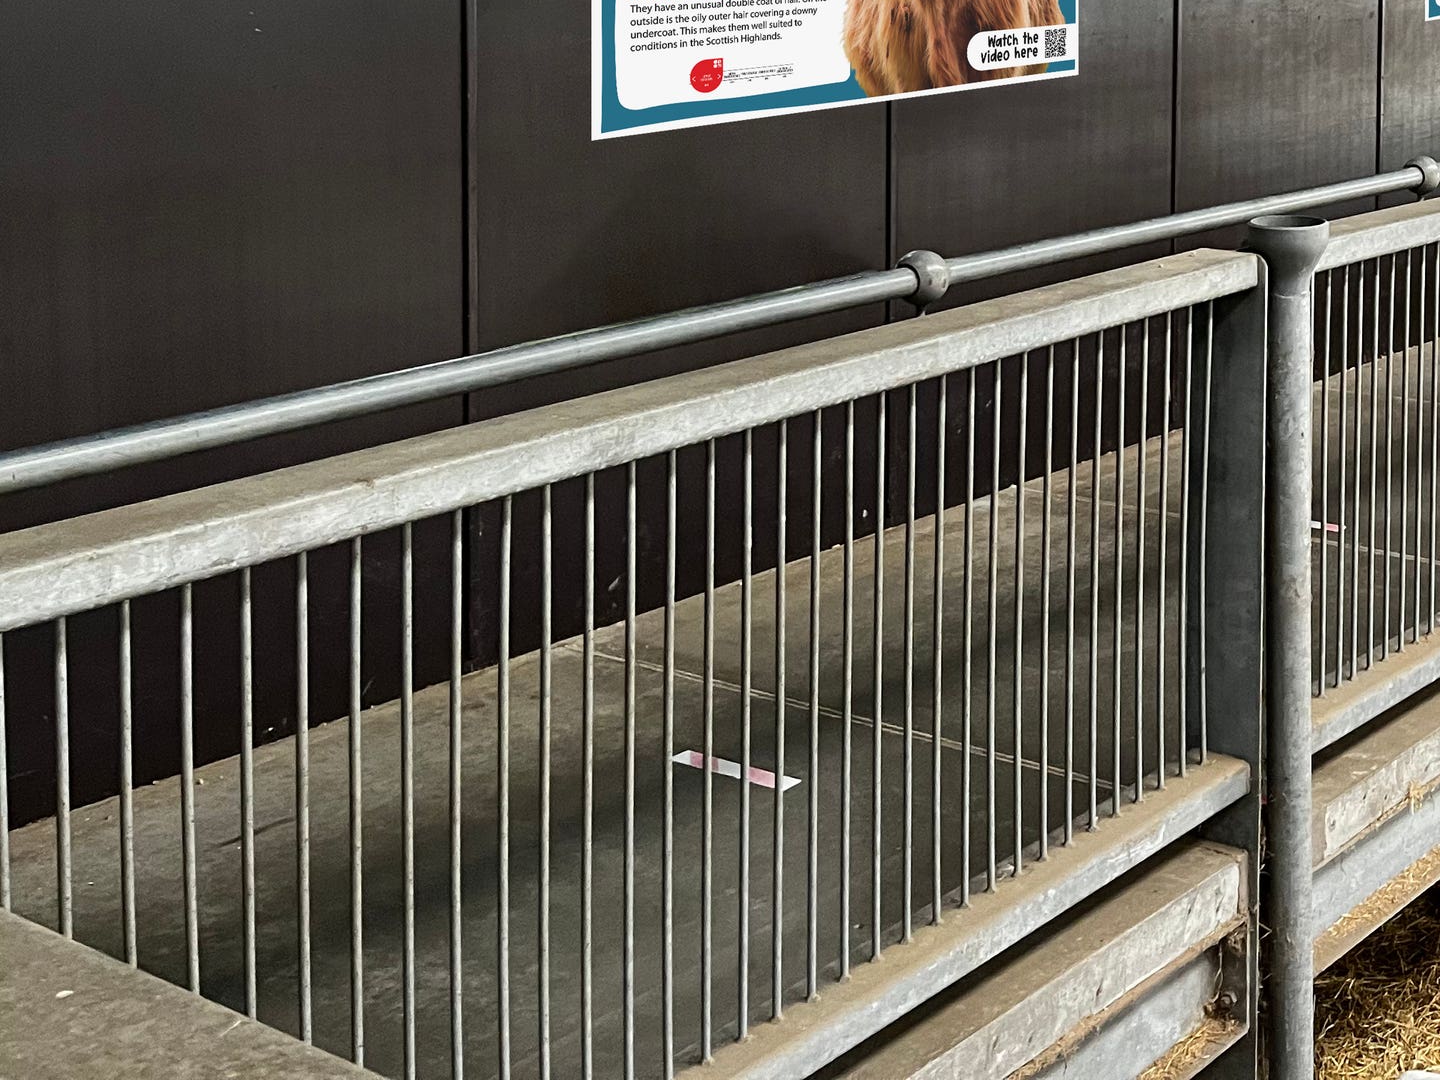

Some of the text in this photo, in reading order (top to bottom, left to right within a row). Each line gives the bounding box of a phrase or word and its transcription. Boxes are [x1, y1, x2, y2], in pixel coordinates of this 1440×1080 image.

[630, 4, 653, 14] They
[654, 3, 676, 12] have
[677, 3, 689, 11] an
[691, 0, 724, 10] unusual
[630, 16, 664, 27] outside
[666, 15, 673, 24] is
[675, 14, 690, 23] the
[691, 13, 707, 23] oily
[708, 13, 731, 21] outer
[733, 11, 748, 19] hair
[750, 9, 784, 18] covering
[630, 19, 803, 39] undercoat. This makes them well suited to
[630, 32, 782, 52] conditions in the Scottish Highlands.
[987, 32, 1039, 48] Watch the
[980, 46, 1038, 63] video here
